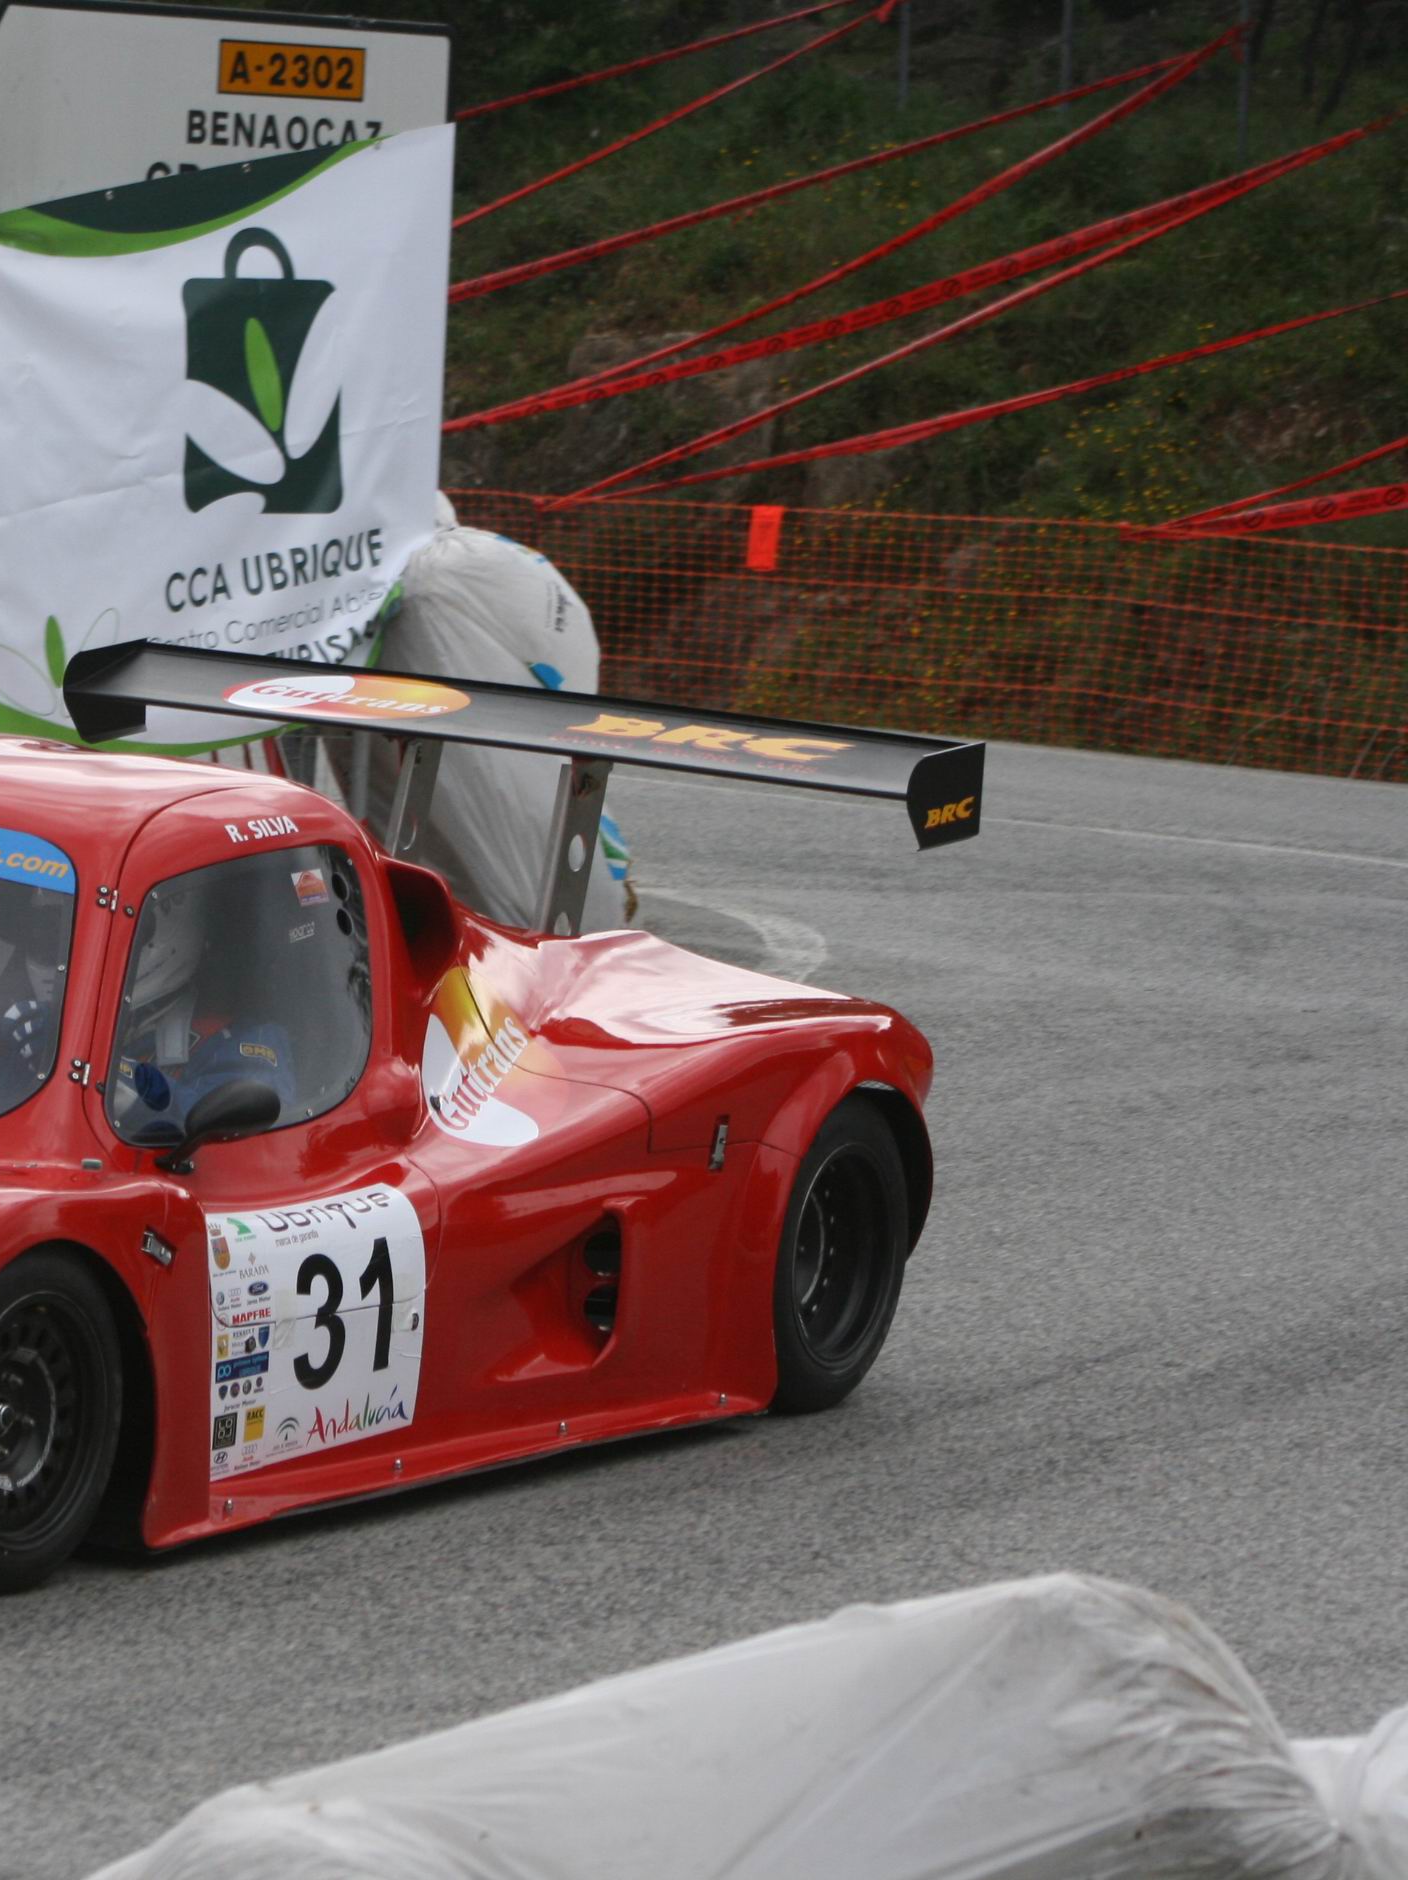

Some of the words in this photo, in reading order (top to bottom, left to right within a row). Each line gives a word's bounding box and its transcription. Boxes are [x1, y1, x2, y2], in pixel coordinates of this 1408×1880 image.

[229, 51, 355, 90] A-2302
[166, 564, 232, 612] CCA
[240, 528, 383, 596] UBRIQUE
[225, 600, 325, 645] Comercial
[252, 684, 448, 714] Guttrans
[566, 713, 857, 762] BRC
[224, 823, 248, 844] R.
[253, 815, 299, 840] SILVA
[924, 796, 976, 829] BRC
[438, 1016, 529, 1131] Guttrans
[255, 1191, 391, 1232] Ubrique
[232, 1306, 272, 1325] MAPFRE
[293, 1236, 395, 1391] 31
[247, 1408, 265, 1421] RACC
[306, 1383, 409, 1448] Andalucía
